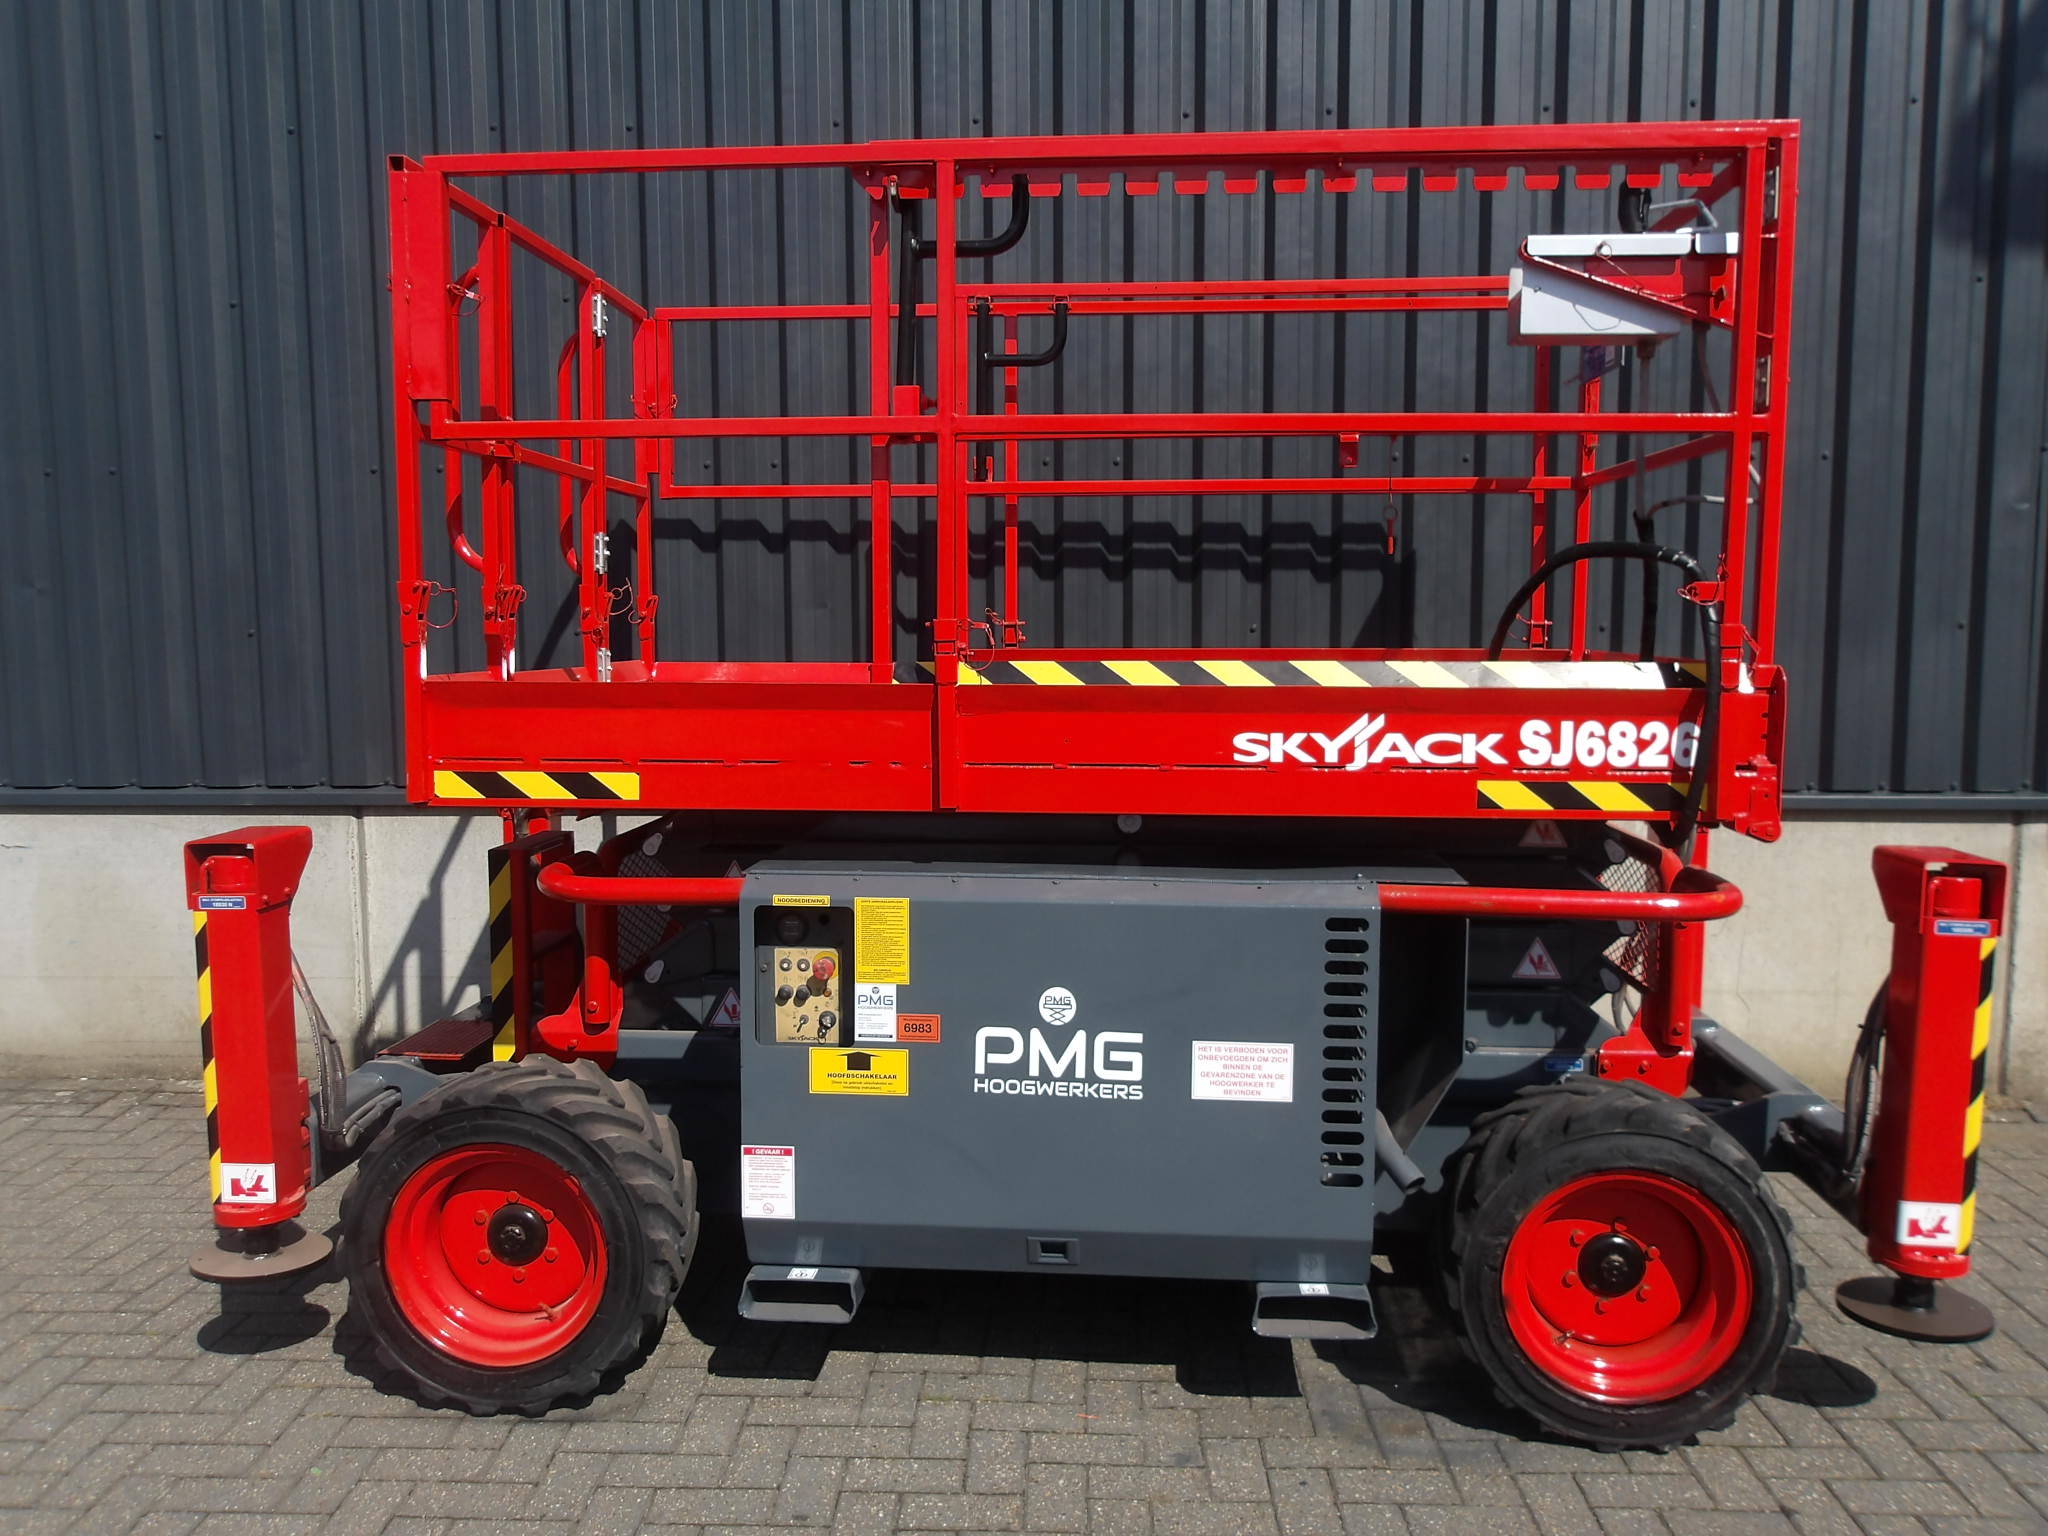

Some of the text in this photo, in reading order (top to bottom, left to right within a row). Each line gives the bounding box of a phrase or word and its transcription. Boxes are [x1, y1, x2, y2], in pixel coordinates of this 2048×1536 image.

[1232, 713, 1698, 771] SKYJACK SJ6826
[858, 994, 894, 1006] PMG
[1044, 995, 1072, 1005] PMG
[903, 1023, 932, 1033] 6983
[974, 1026, 1144, 1081] PMG
[1224, 1046, 1265, 1054] VERBODEN
[1267, 1047, 1288, 1055] VOOR
[1197, 1054, 1255, 1062] ONBEVOEGDEN
[827, 1072, 897, 1080] HOOFDSCHAKELAAR
[1199, 1071, 1256, 1079] GEVARENZONE
[973, 1077, 1144, 1100] HOOGWERKERS
[1209, 1080, 1264, 1088] HOOGWERKER
